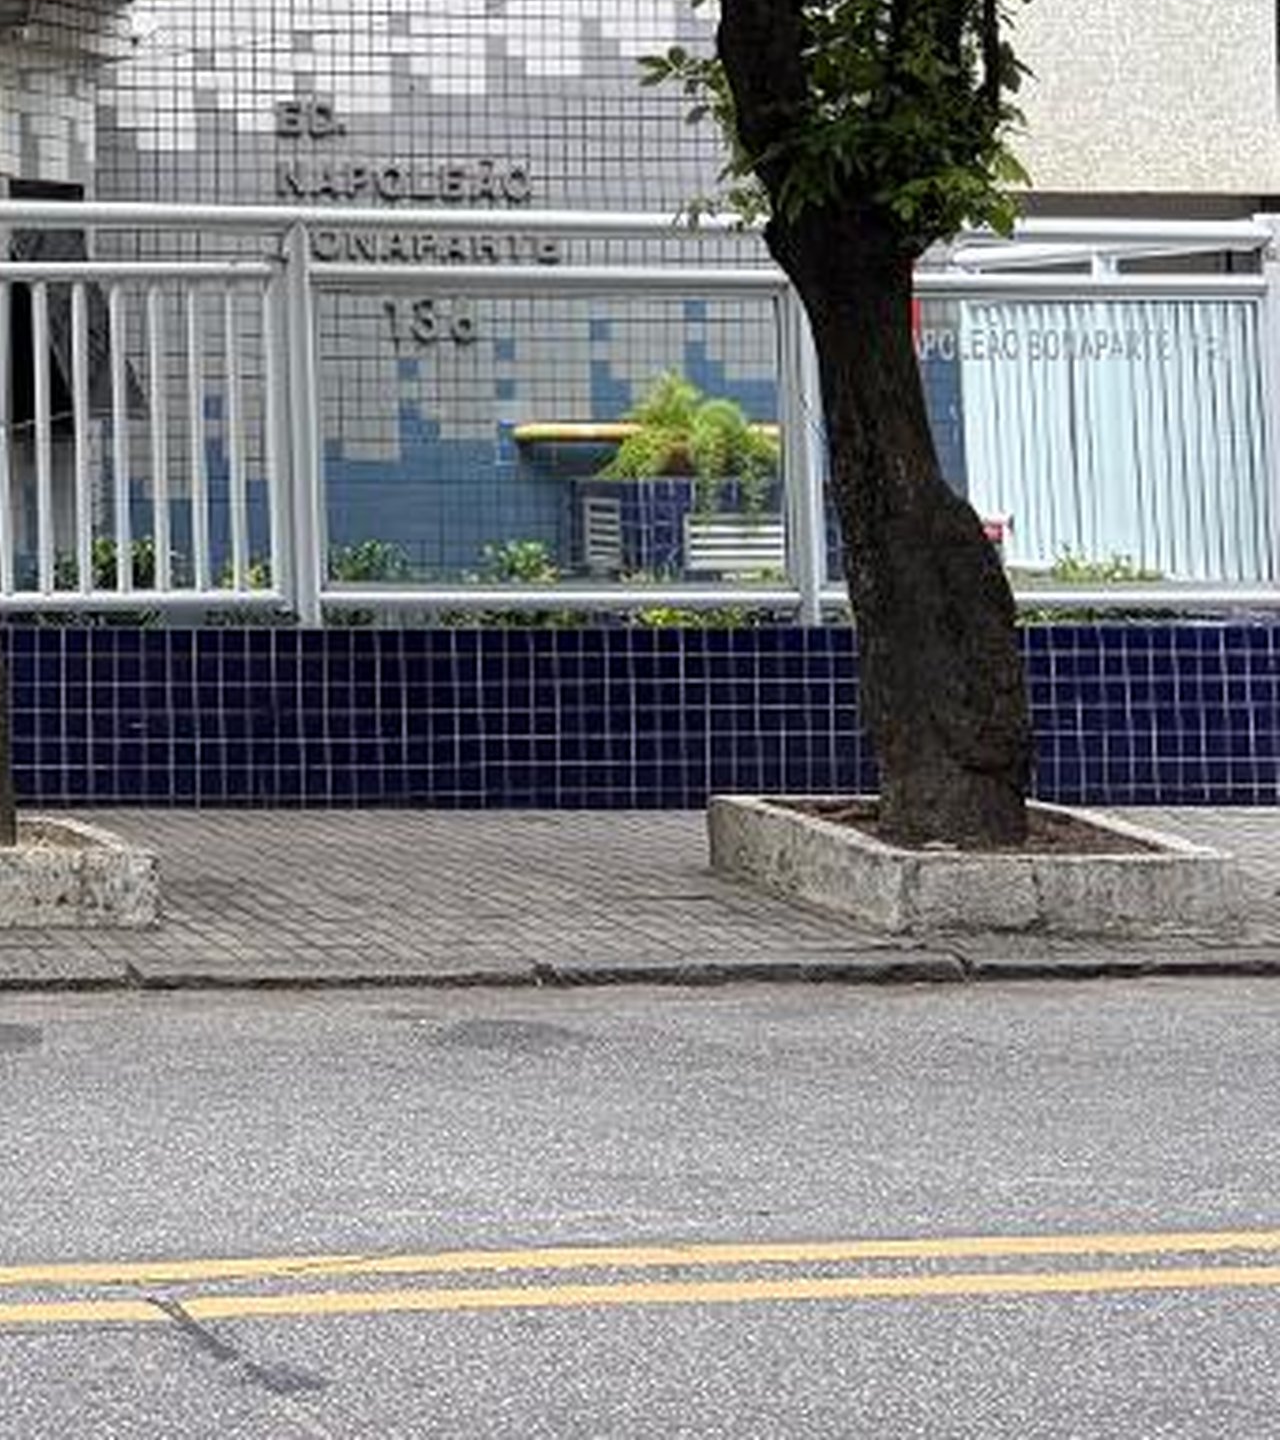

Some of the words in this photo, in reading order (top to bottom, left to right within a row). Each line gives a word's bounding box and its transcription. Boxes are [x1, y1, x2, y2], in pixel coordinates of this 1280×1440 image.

[276, 101, 346, 138] ED.
[276, 157, 531, 202] NAPOLEÃO
[279, 228, 561, 265] ONAPARTE
